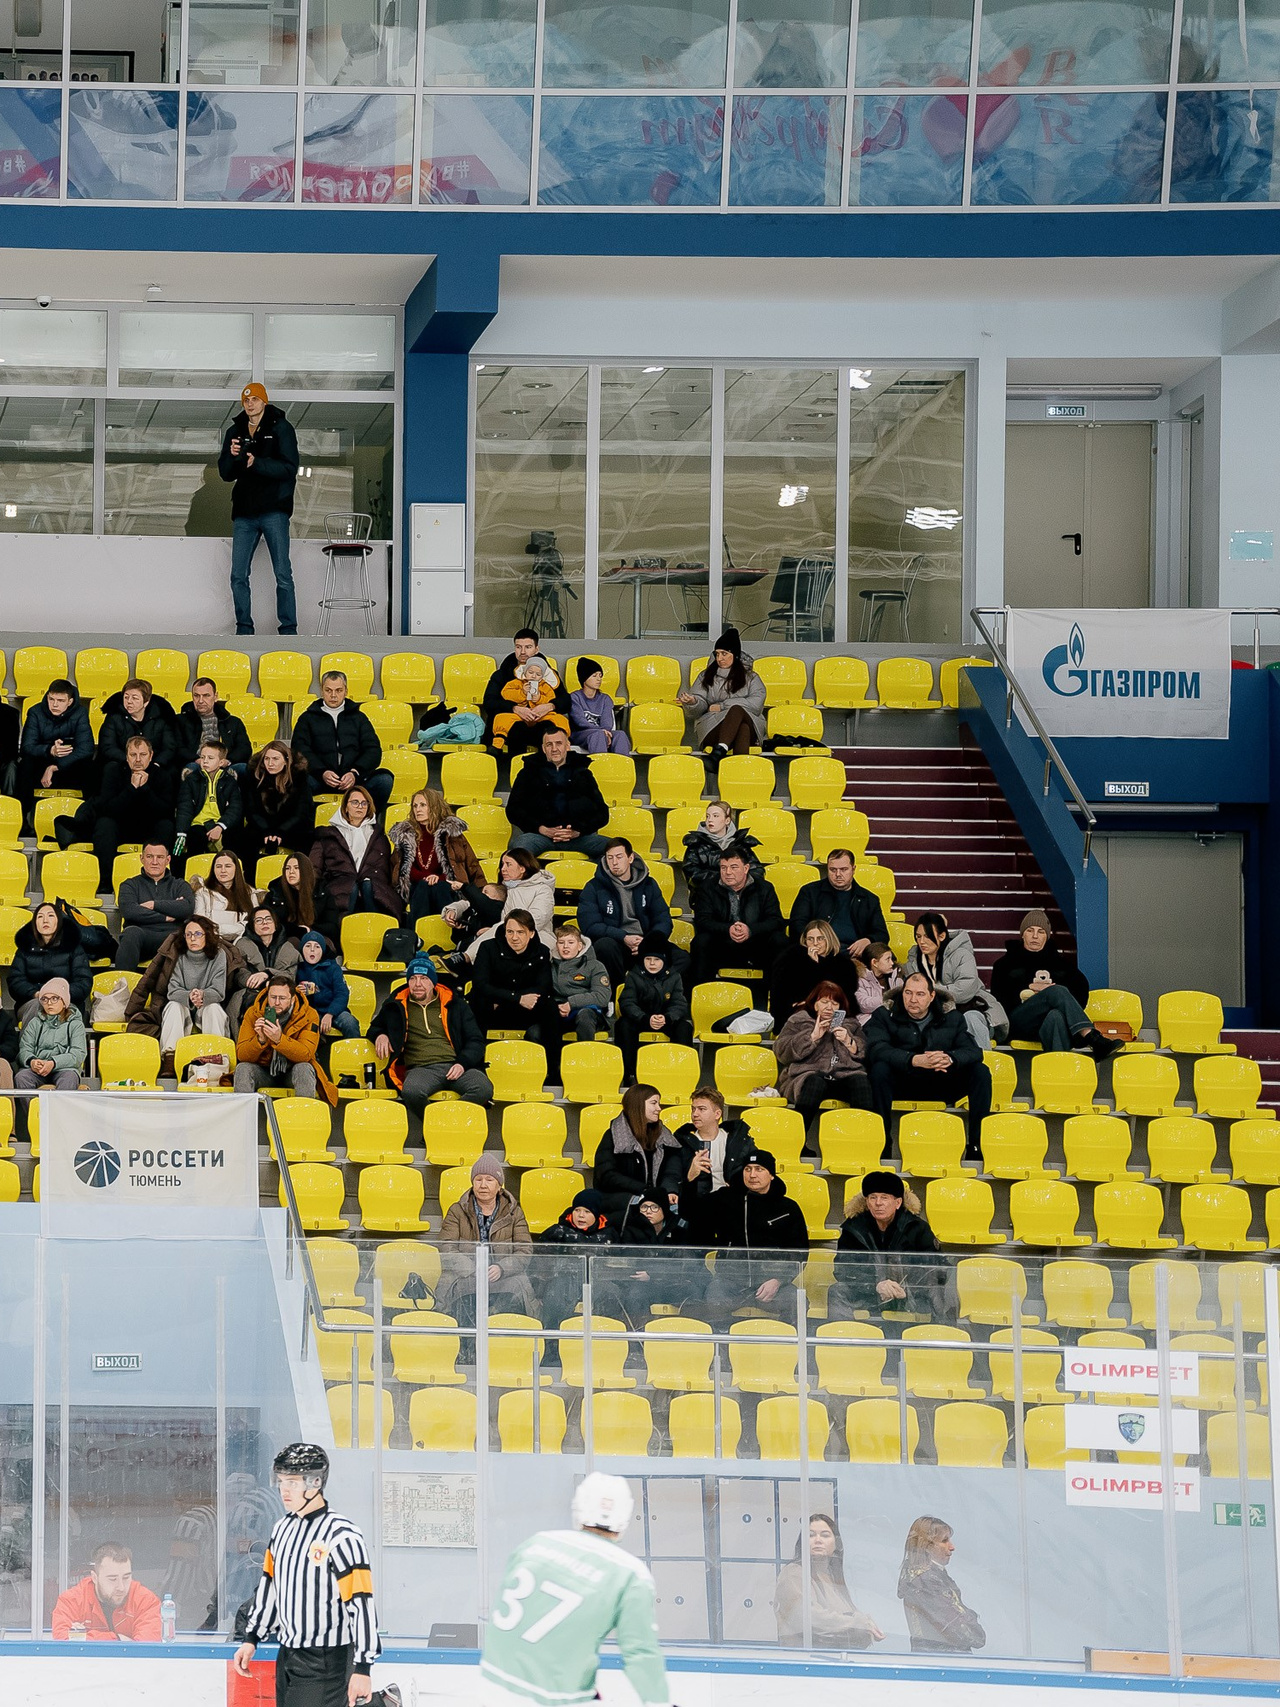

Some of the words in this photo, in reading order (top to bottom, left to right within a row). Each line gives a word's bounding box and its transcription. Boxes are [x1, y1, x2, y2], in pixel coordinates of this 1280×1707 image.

[1049, 406, 1083, 416] ВЫХОД
[1091, 669, 1201, 699] ГАЗПРОМ
[1108, 784, 1145, 795] ВЫХОД
[128, 1149, 225, 1168] РОССЕТИ
[129, 1175, 182, 1187] ТЮМЕНЬ
[96, 1356, 138, 1368] ВЫХОД
[1071, 1476, 1195, 1496] OLIMPBT
[491, 1566, 584, 1644] 37
